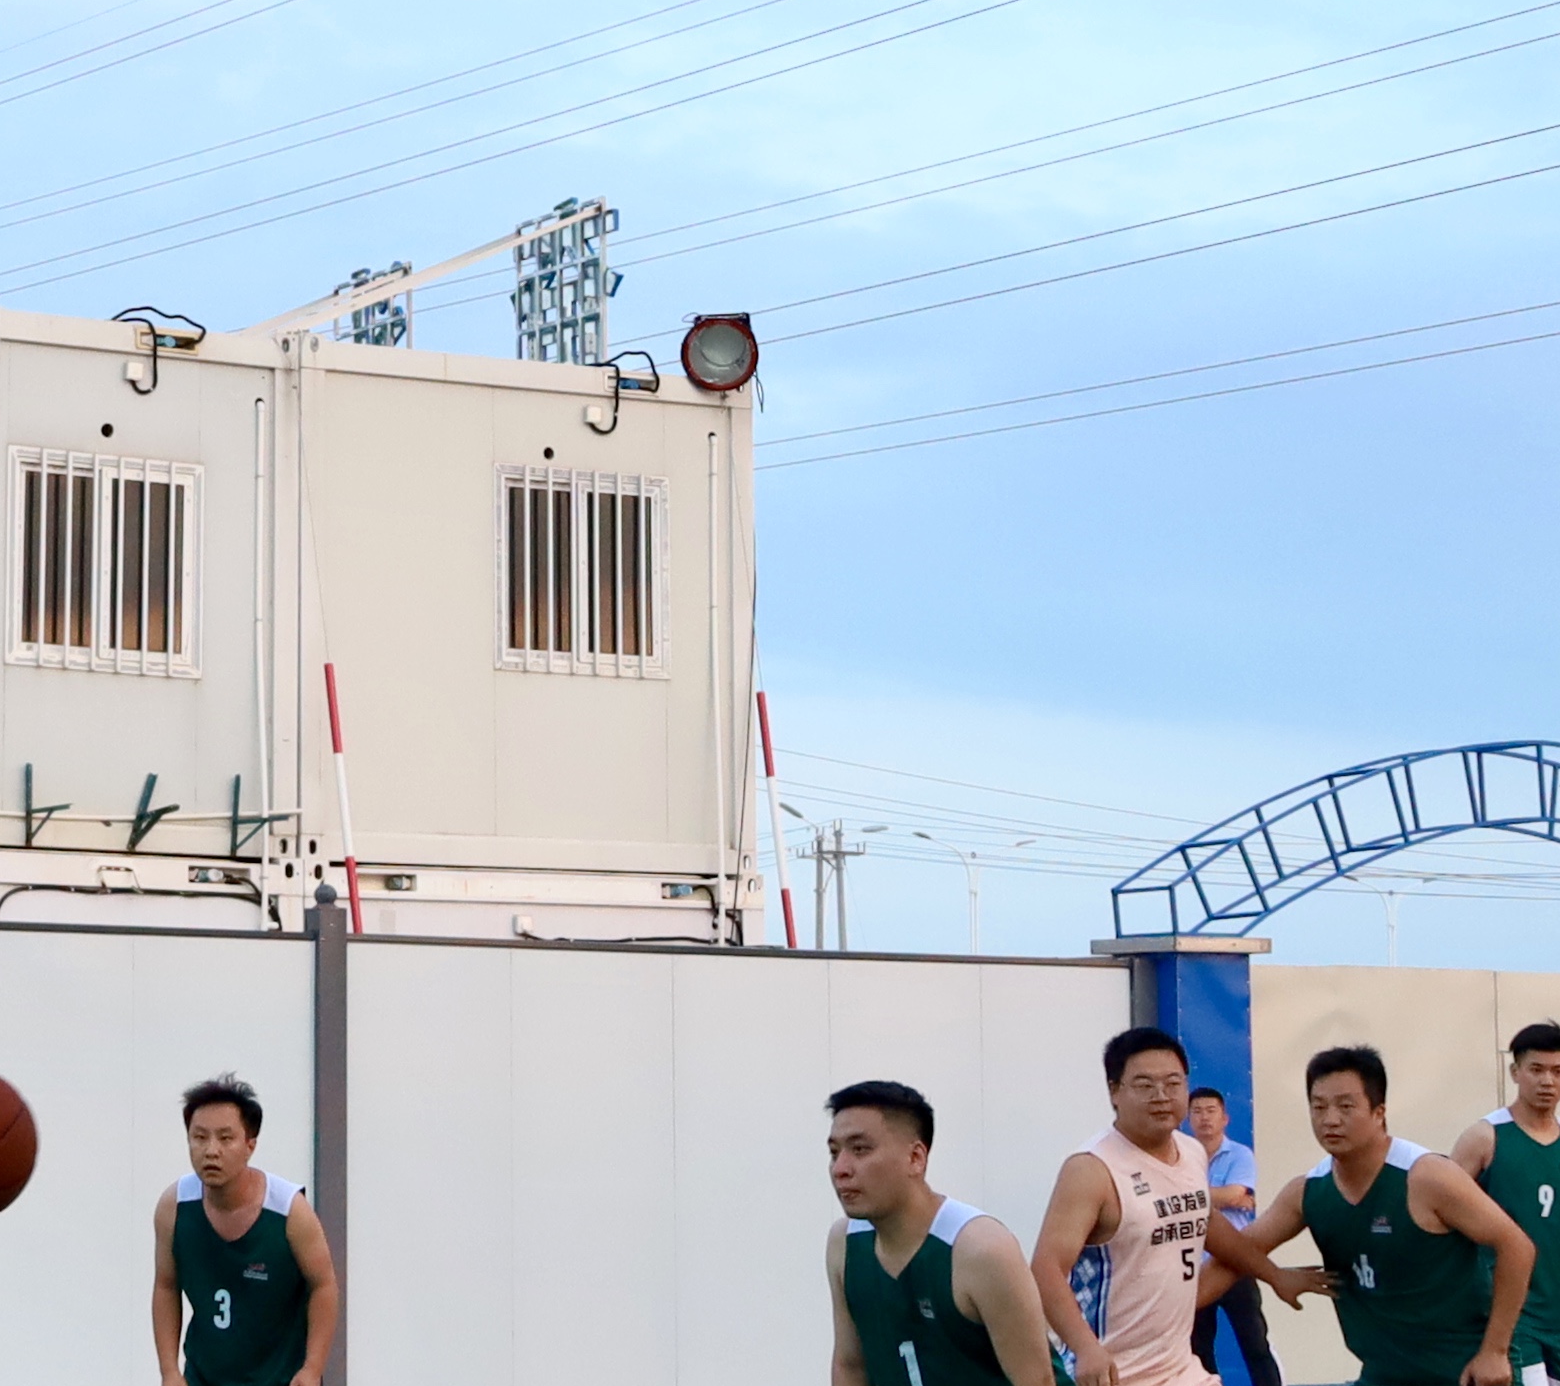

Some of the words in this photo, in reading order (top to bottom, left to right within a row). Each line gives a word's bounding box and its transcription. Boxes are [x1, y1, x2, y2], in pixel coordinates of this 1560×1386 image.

[1538, 1184, 1555, 1218] 9
[1150, 1217, 1209, 1246] 总承包公
[1181, 1248, 1195, 1281] 5
[213, 1289, 231, 1329] 3
